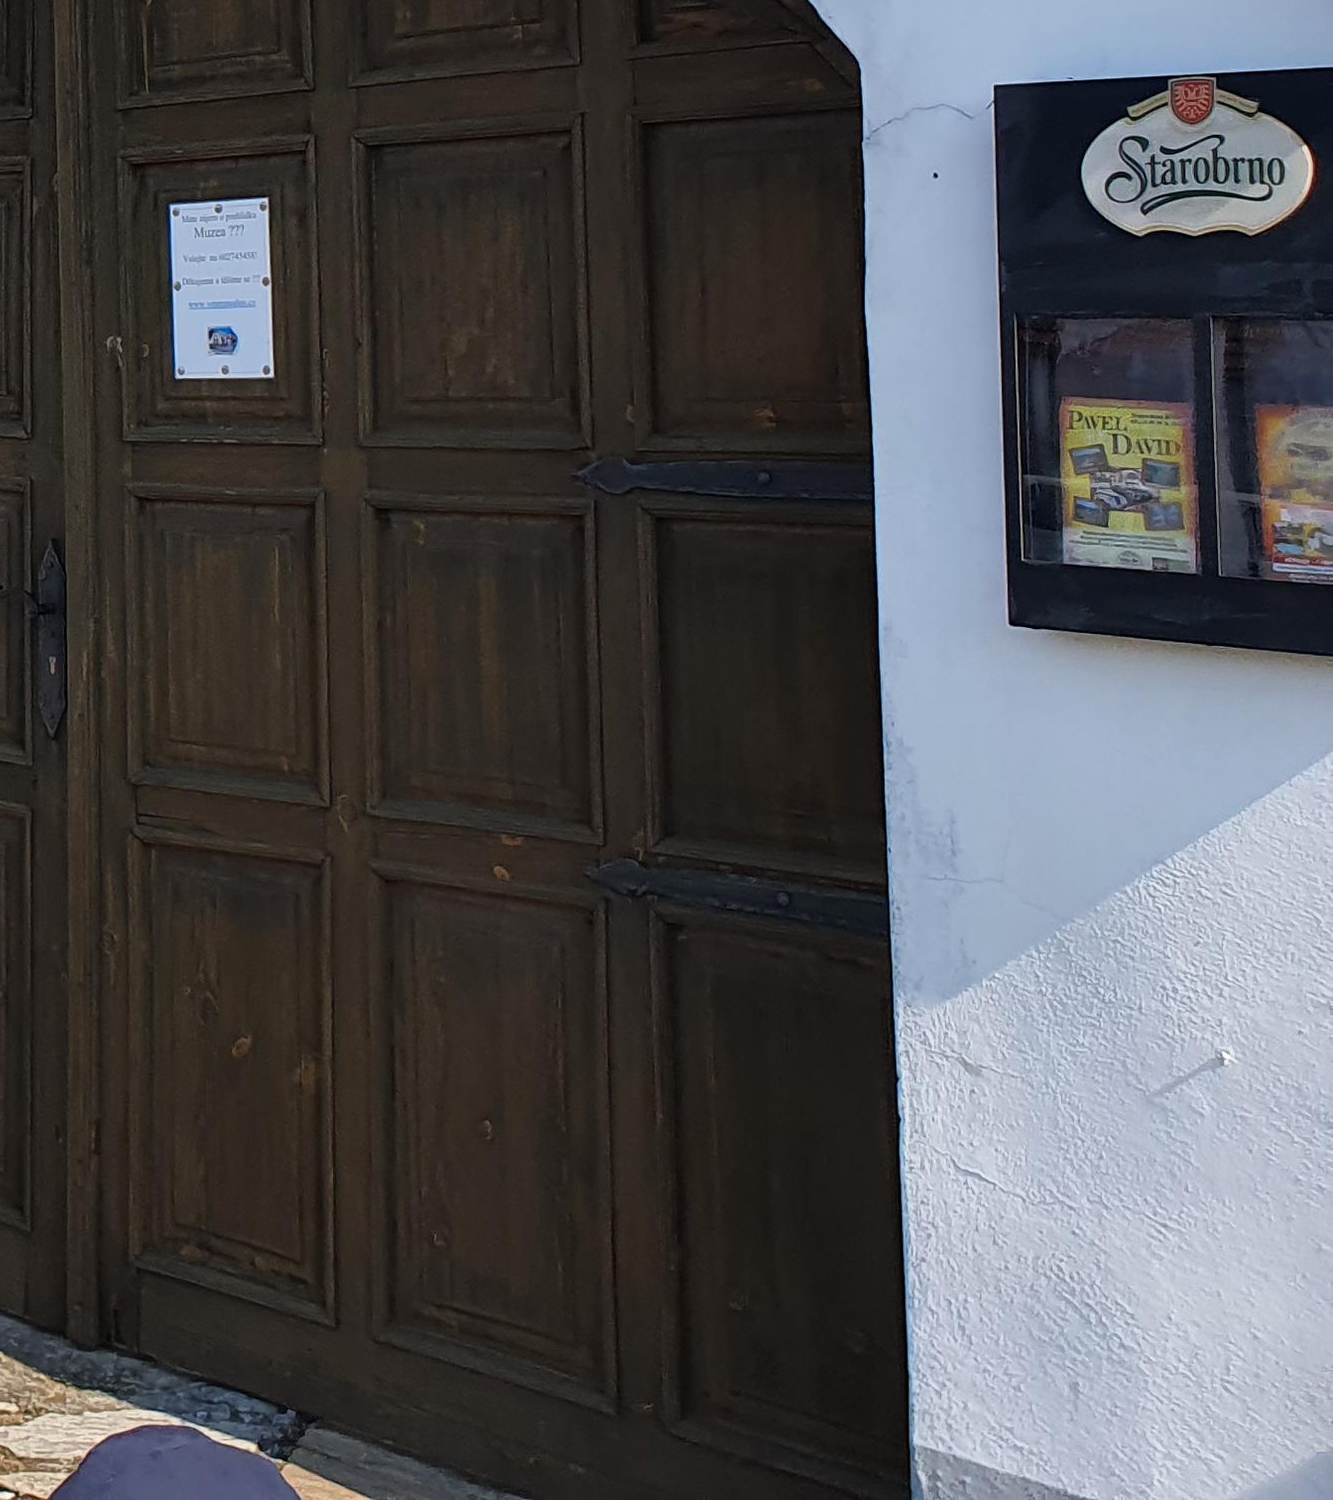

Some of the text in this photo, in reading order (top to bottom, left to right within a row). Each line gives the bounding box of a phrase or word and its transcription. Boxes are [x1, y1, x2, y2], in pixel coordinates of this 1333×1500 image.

[1104, 134, 1285, 215] Starobrno
[193, 226, 226, 239] Muzea
[1068, 410, 1127, 431] PAVEL
[1108, 433, 1181, 455] DAVID
